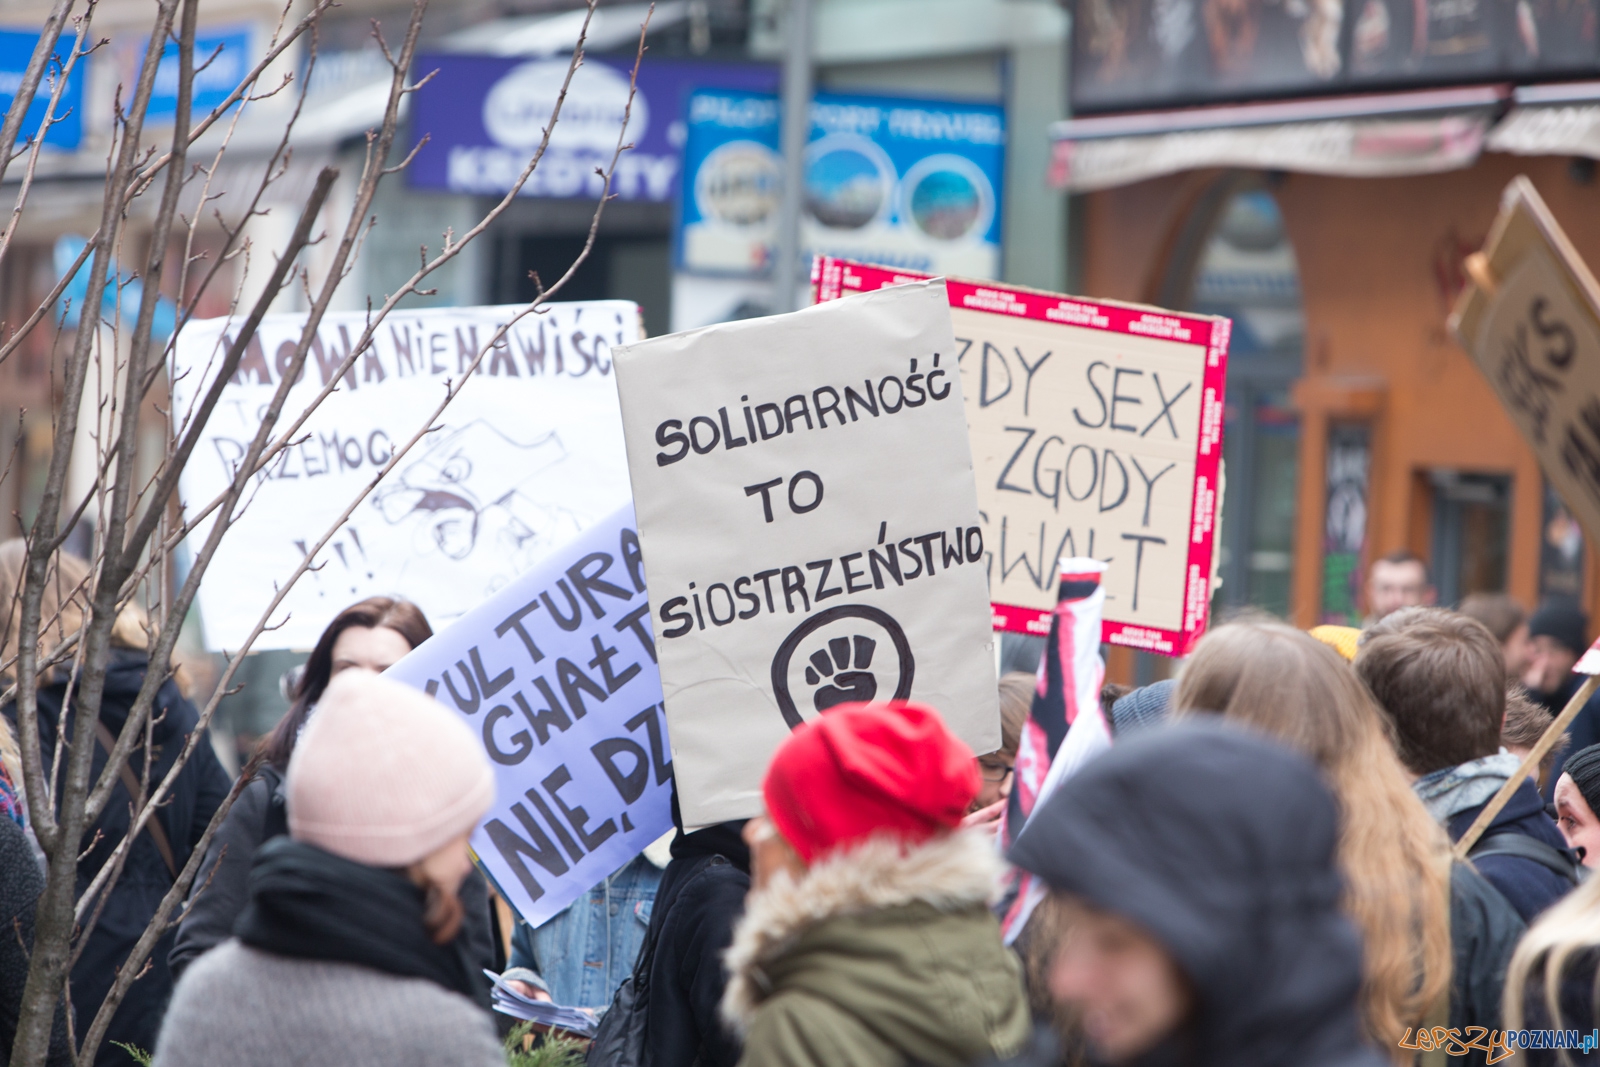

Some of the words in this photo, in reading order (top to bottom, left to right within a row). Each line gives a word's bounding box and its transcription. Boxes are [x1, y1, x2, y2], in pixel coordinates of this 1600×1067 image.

[447, 146, 677, 201] KREDYTY
[1073, 360, 1192, 439] SEX
[744, 470, 824, 523] TO
[996, 426, 1176, 527] ZGODY
[482, 603, 659, 767] GWAŁT
